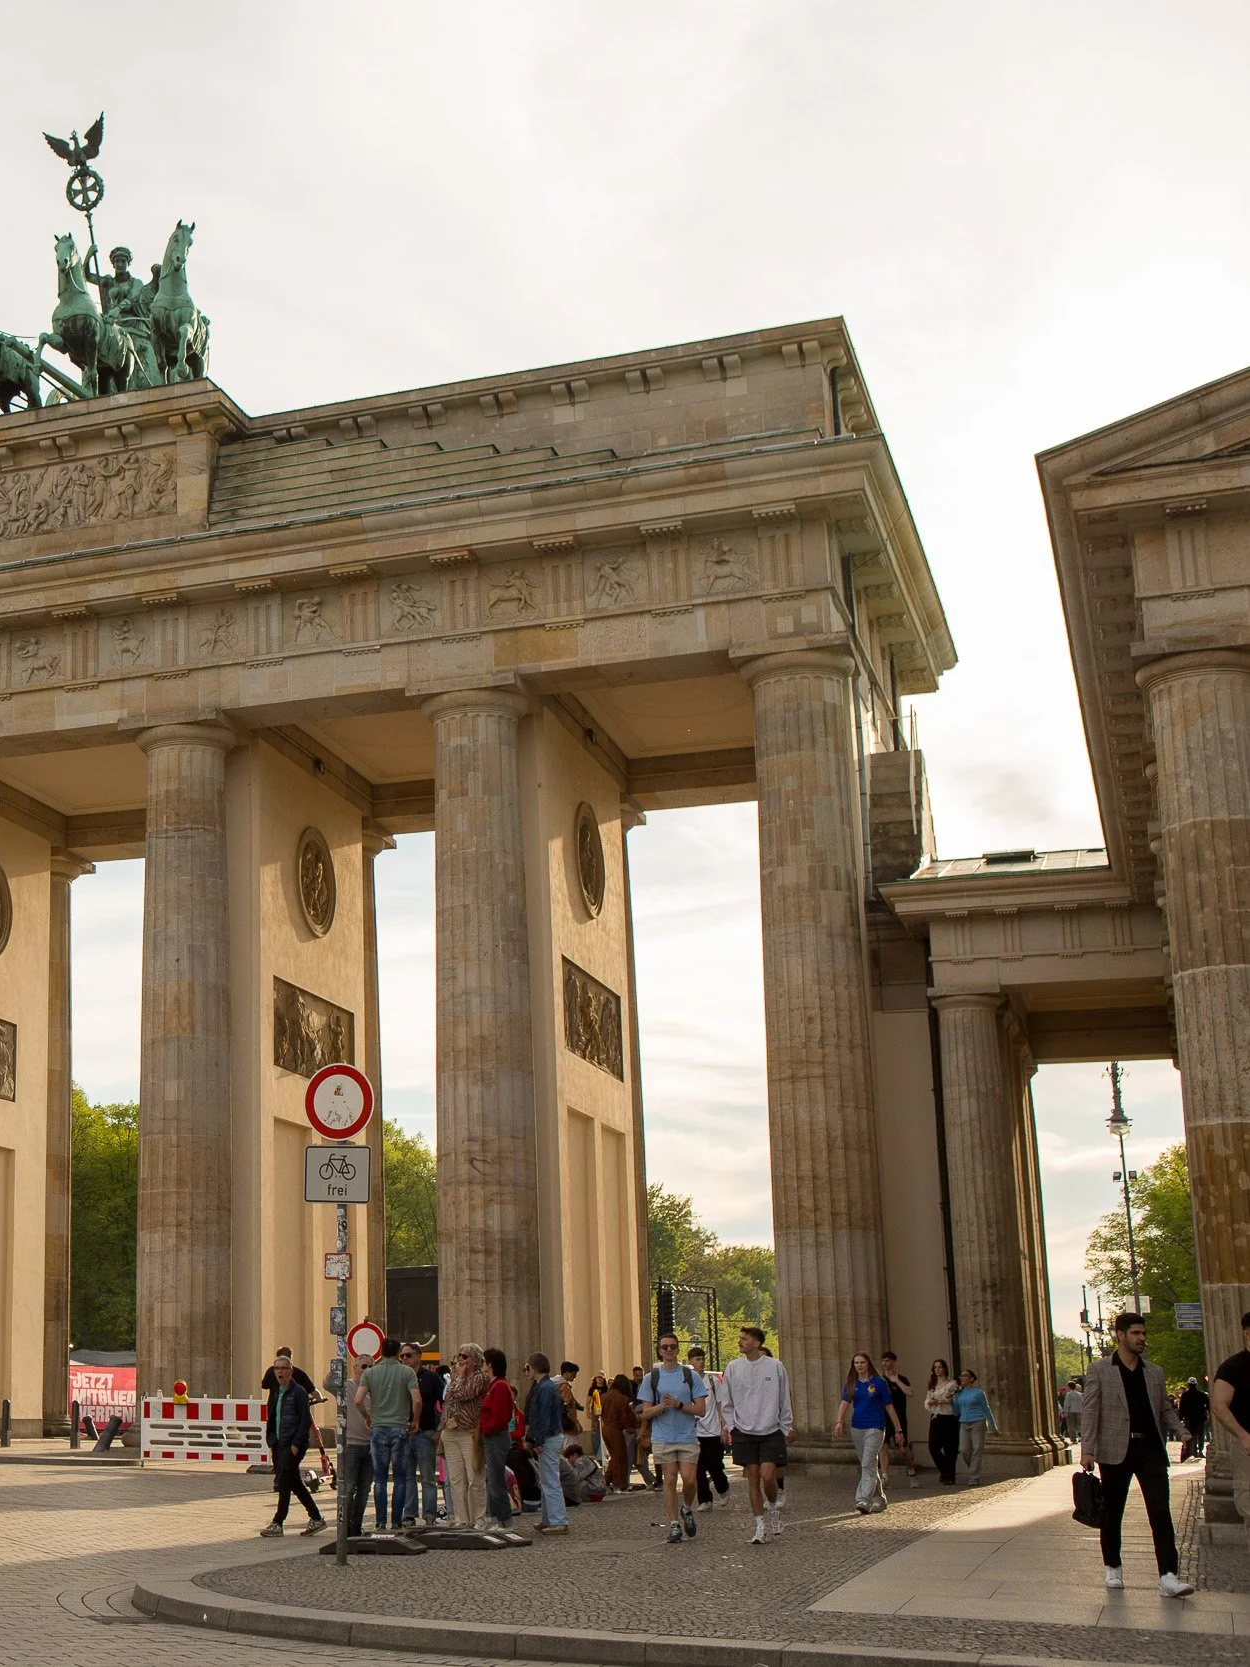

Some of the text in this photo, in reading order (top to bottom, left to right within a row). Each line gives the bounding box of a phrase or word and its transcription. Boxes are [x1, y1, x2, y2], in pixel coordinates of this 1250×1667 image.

[327, 1183, 347, 1196] frei
[69, 1372, 114, 1389] JETZT
[72, 1388, 136, 1406] MITGLIED
